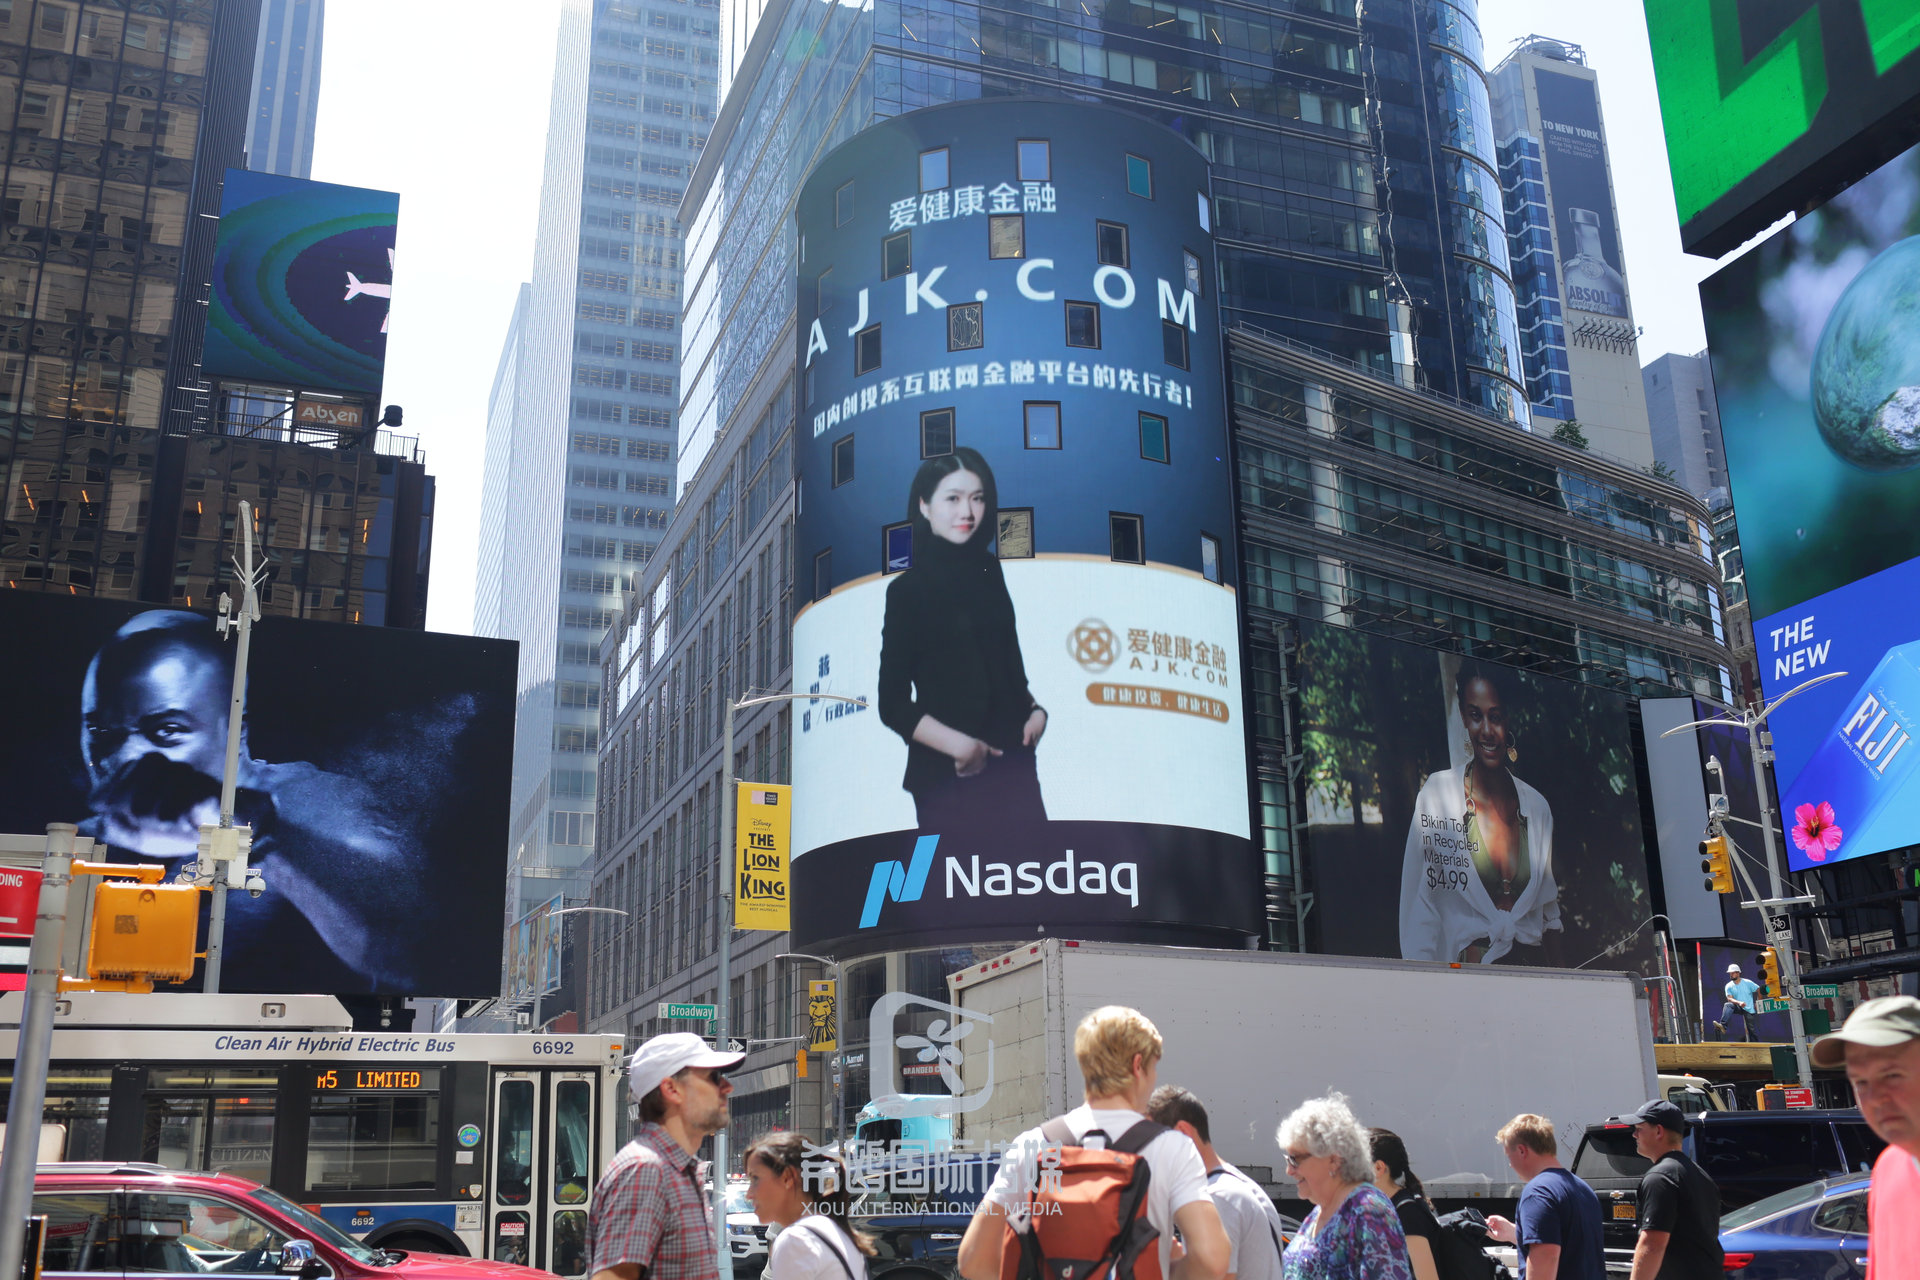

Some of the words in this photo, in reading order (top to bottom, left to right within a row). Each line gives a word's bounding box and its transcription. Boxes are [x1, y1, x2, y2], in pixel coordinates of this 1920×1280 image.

[1542, 119, 1554, 130] TO
[1555, 122, 1574, 135] NEW
[889, 181, 1056, 232] 爱健康金融
[301, 404, 359, 424] Absen
[1770, 615, 1815, 652] THE
[1128, 628, 1227, 673] 爱健康金融
[1775, 639, 1832, 681] NEW
[1842, 692, 1911, 774] FIJI
[1421, 813, 1448, 831] Bikini
[1450, 818, 1469, 836] Top
[748, 832, 775, 847] THE
[1422, 831, 1432, 845] in
[1434, 833, 1479, 853] Recycled
[743, 848, 780, 872] LION
[1424, 849, 1470, 868] Materials
[740, 872, 785, 900] KING
[945, 849, 1139, 908] Nasdaq
[1426, 865, 1468, 892] $4.99
[1806, 986, 1836, 998] Broadway
[670, 1005, 713, 1020] Broadway
[1764, 1002, 1771, 1011] W
[1773, 1000, 1782, 1009] 43
[214, 1035, 262, 1051] Clean
[266, 1037, 293, 1051] Air
[296, 1036, 352, 1055] Hybrid
[357, 1037, 420, 1053] Electric
[425, 1038, 455, 1053] Bus
[532, 1041, 574, 1055] 6692
[356, 1071, 420, 1088] LIMITED
[351, 1217, 375, 1226] 6692
